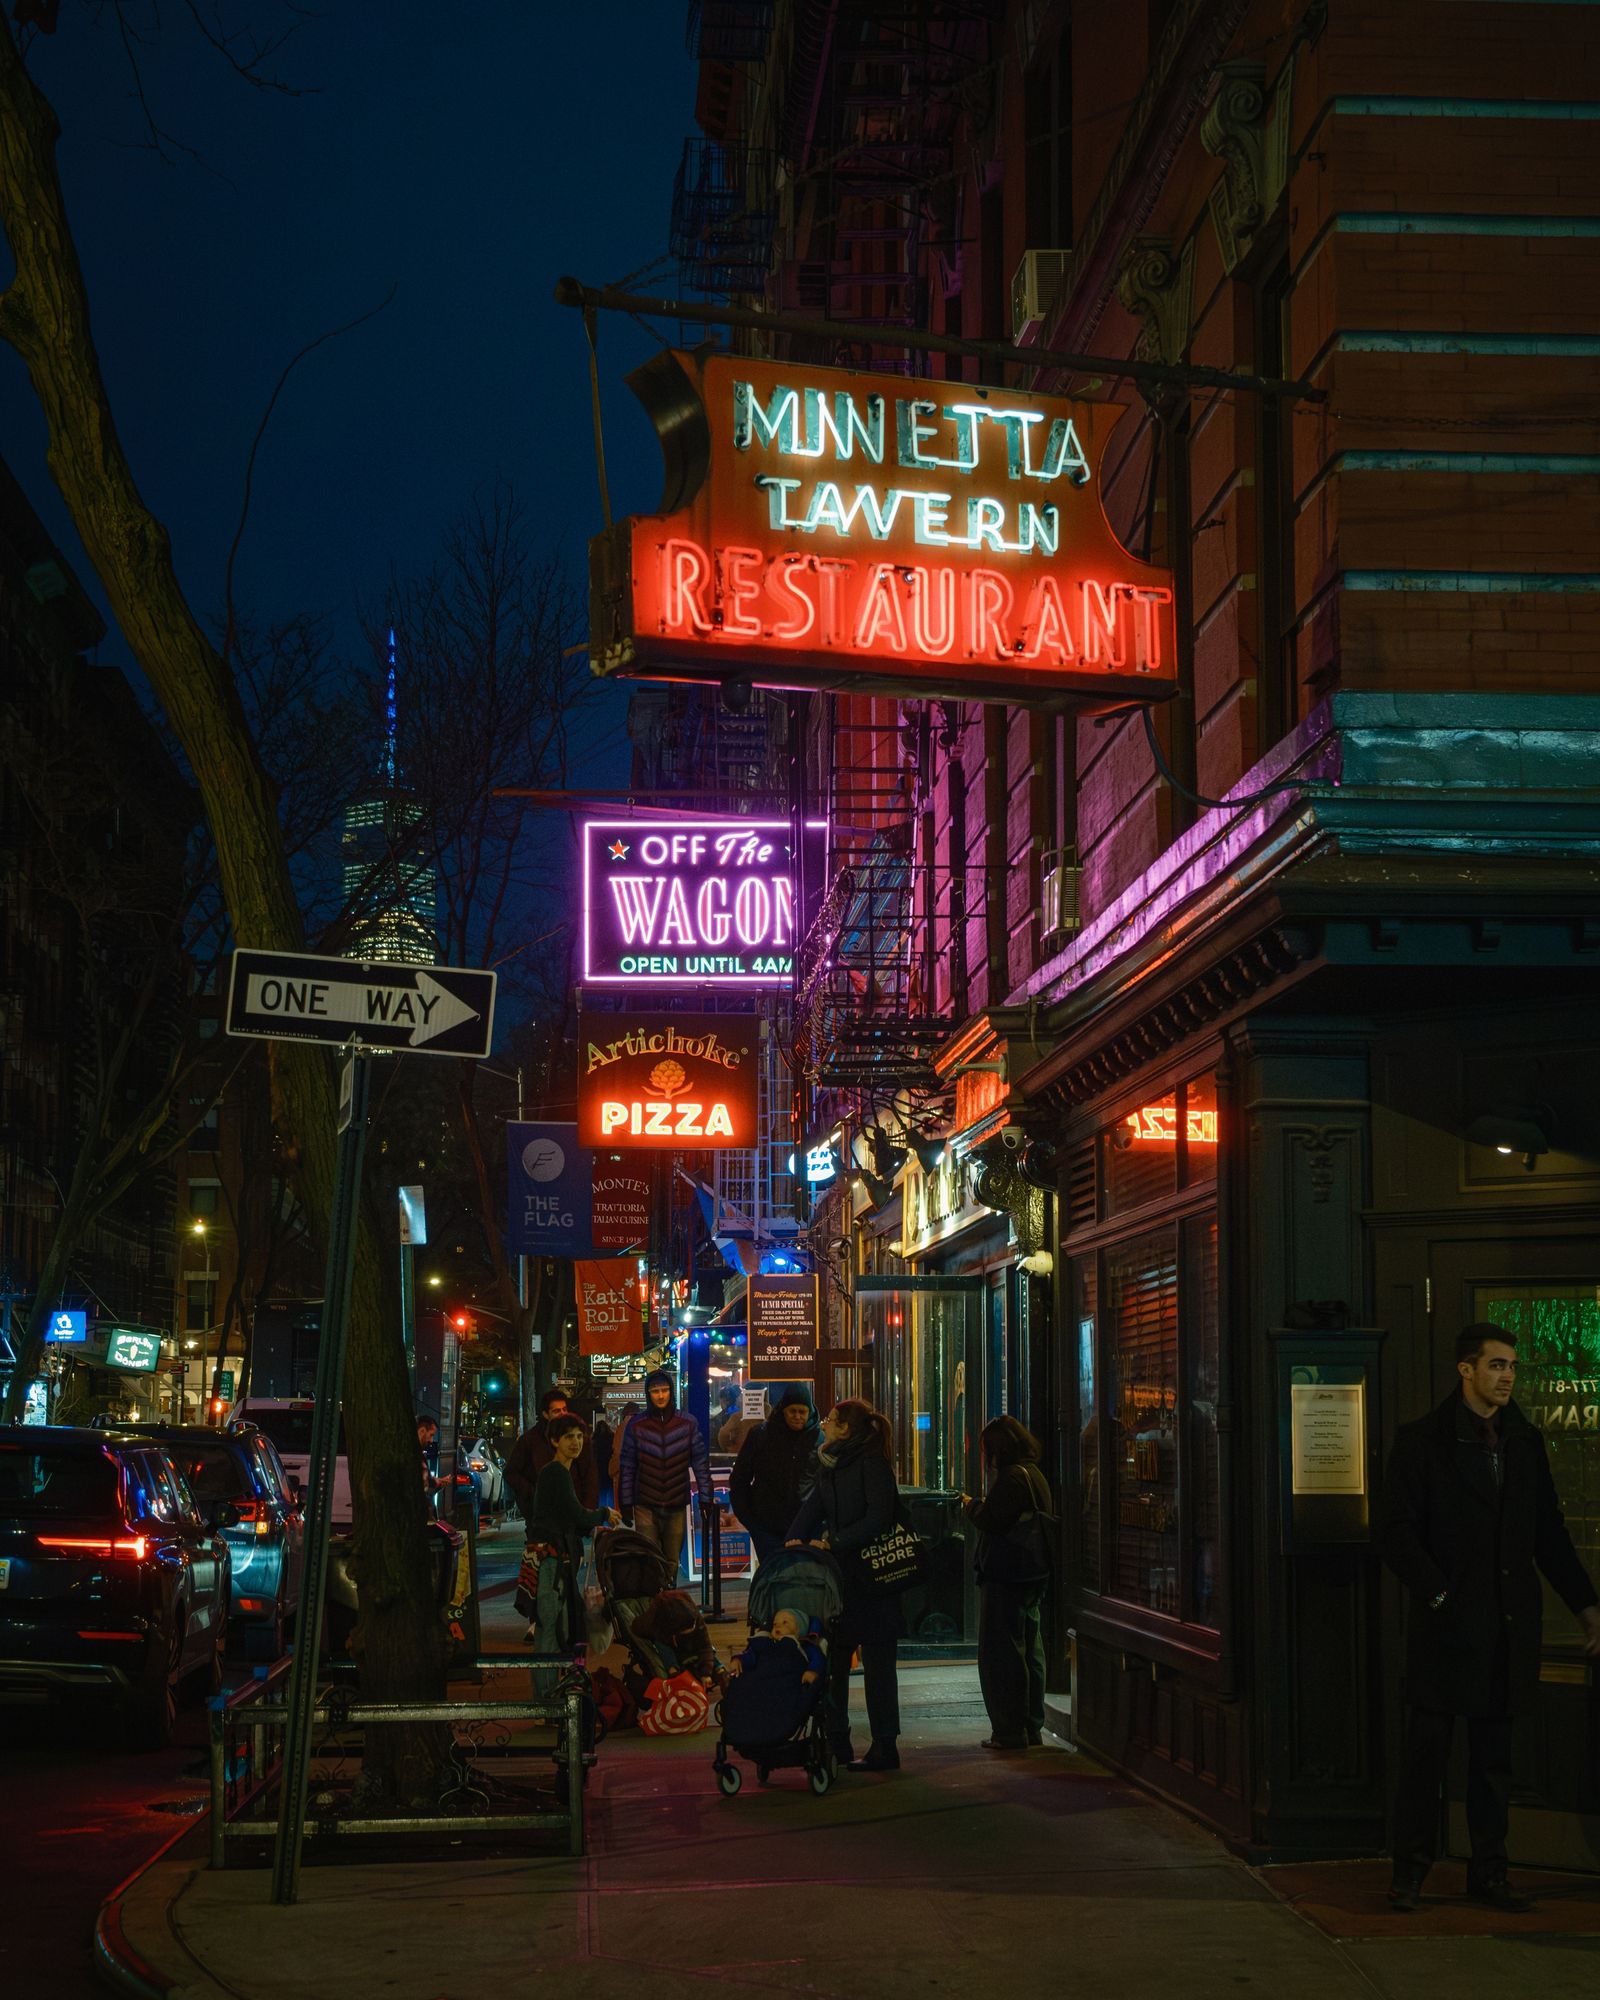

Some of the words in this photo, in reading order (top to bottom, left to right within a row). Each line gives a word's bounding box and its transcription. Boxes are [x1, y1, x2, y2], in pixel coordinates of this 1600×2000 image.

[732, 380, 1090, 484] MINETTA
[755, 473, 1059, 554] TAVERN
[658, 538, 1172, 671] RESTAURANT
[641, 835, 706, 865] OFF
[715, 830, 773, 866] The
[620, 956, 677, 974] OPEN
[686, 957, 745, 974] UNTIL
[752, 957, 793, 974] 4AM
[260, 980, 330, 1015] ONE
[366, 989, 441, 1025] WAY
[585, 1026, 741, 1075] Artichoke
[600, 1102, 735, 1136] PIZZA
[592, 1178, 650, 1196] MONTE'S
[524, 1195, 560, 1211] THE
[594, 1203, 646, 1213] TRATTORIA
[524, 1211, 575, 1228] FLAG
[601, 1236, 624, 1244] SINCE
[583, 1282, 597, 1290] The
[584, 1288, 629, 1305] Kati
[761, 1300, 780, 1309] LUNCH
[781, 1300, 805, 1309] SPECIAL
[585, 1307, 630, 1325] Roll
[585, 1323, 619, 1333] Company
[766, 1346, 778, 1355] $2
[780, 1346, 801, 1355] OFF
[860, 1531, 921, 1560] GENERAL
[871, 1546, 916, 1570] STORE
